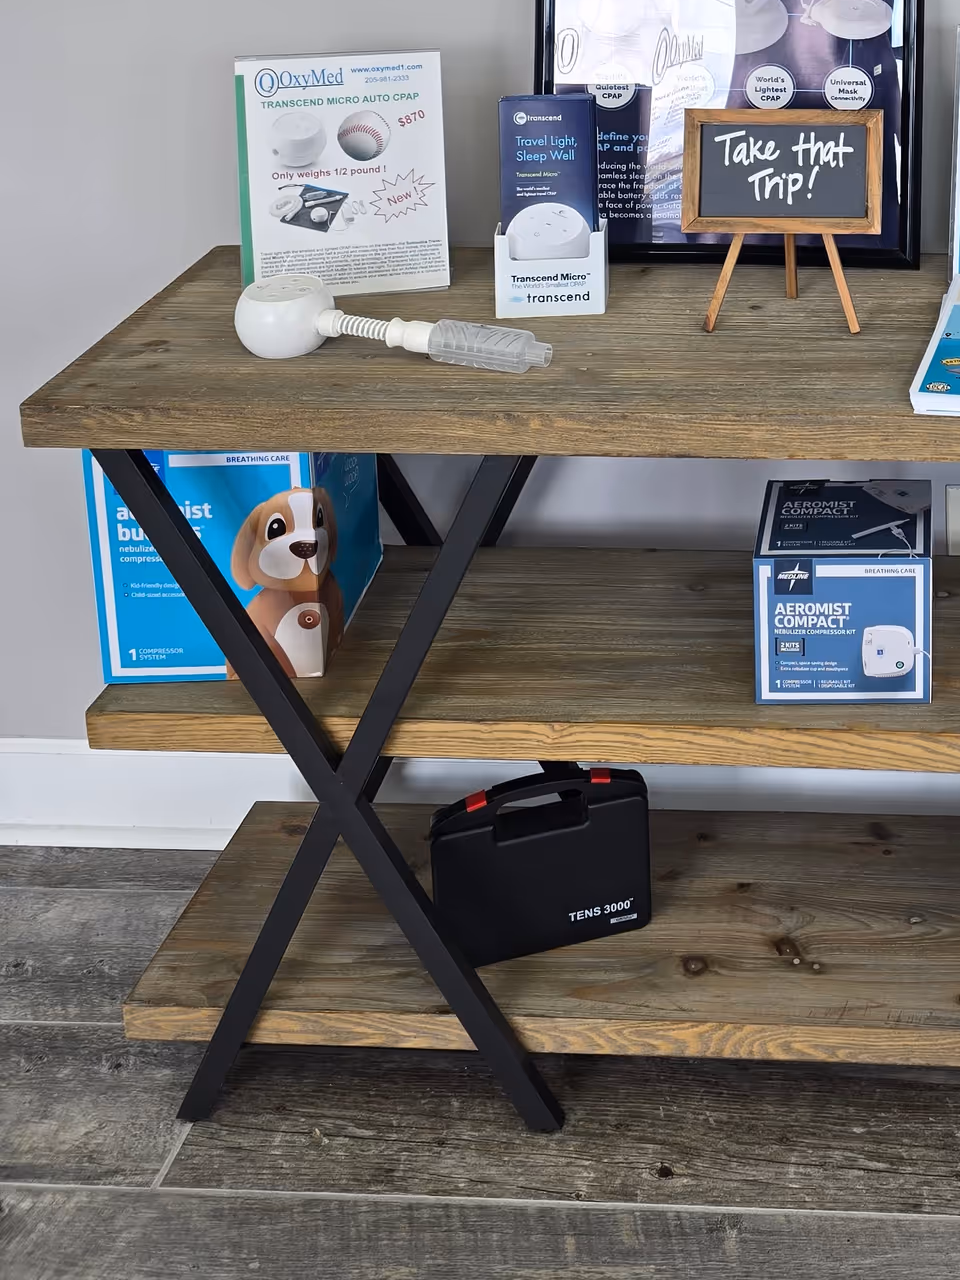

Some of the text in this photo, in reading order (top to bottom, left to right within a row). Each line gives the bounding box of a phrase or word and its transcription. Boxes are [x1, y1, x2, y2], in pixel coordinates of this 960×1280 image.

[350, 63, 423, 73] www.oxymed1.com
[279, 68, 344, 90] OxyMed
[755, 86, 787, 94] Lightest
[261, 92, 420, 110] TRANSCEND MICRO AUTO CPAP
[397, 109, 426, 128] $870
[527, 114, 562, 122] transcend
[515, 134, 578, 149] Travel Light,
[613, 143, 634, 152] and
[714, 130, 781, 167] Take
[791, 131, 854, 168] that
[516, 149, 575, 164] Sleep Well
[628, 162, 641, 170] the
[271, 171, 294, 181] Only
[297, 168, 331, 179] weighs
[334, 167, 348, 176] 1/2
[350, 165, 381, 176] pound
[629, 171, 650, 181] sleep
[618, 181, 631, 189] the
[747, 165, 820, 205] Trip!
[387, 190, 412, 207] New
[617, 191, 647, 200] battery
[605, 201, 662, 210] face of power
[609, 210, 644, 219] becomes
[511, 273, 559, 283] Transcend
[526, 290, 590, 303] transcend
[226, 454, 290, 463] BREATHING CARE
[783, 500, 857, 508] AEROMIST
[781, 507, 851, 515] COMPACT
[119, 545, 157, 553] nebulize
[774, 602, 852, 615] AEROMIST
[128, 648, 137, 661] 1
[775, 679, 781, 689] 1
[568, 906, 602, 922] TENS
